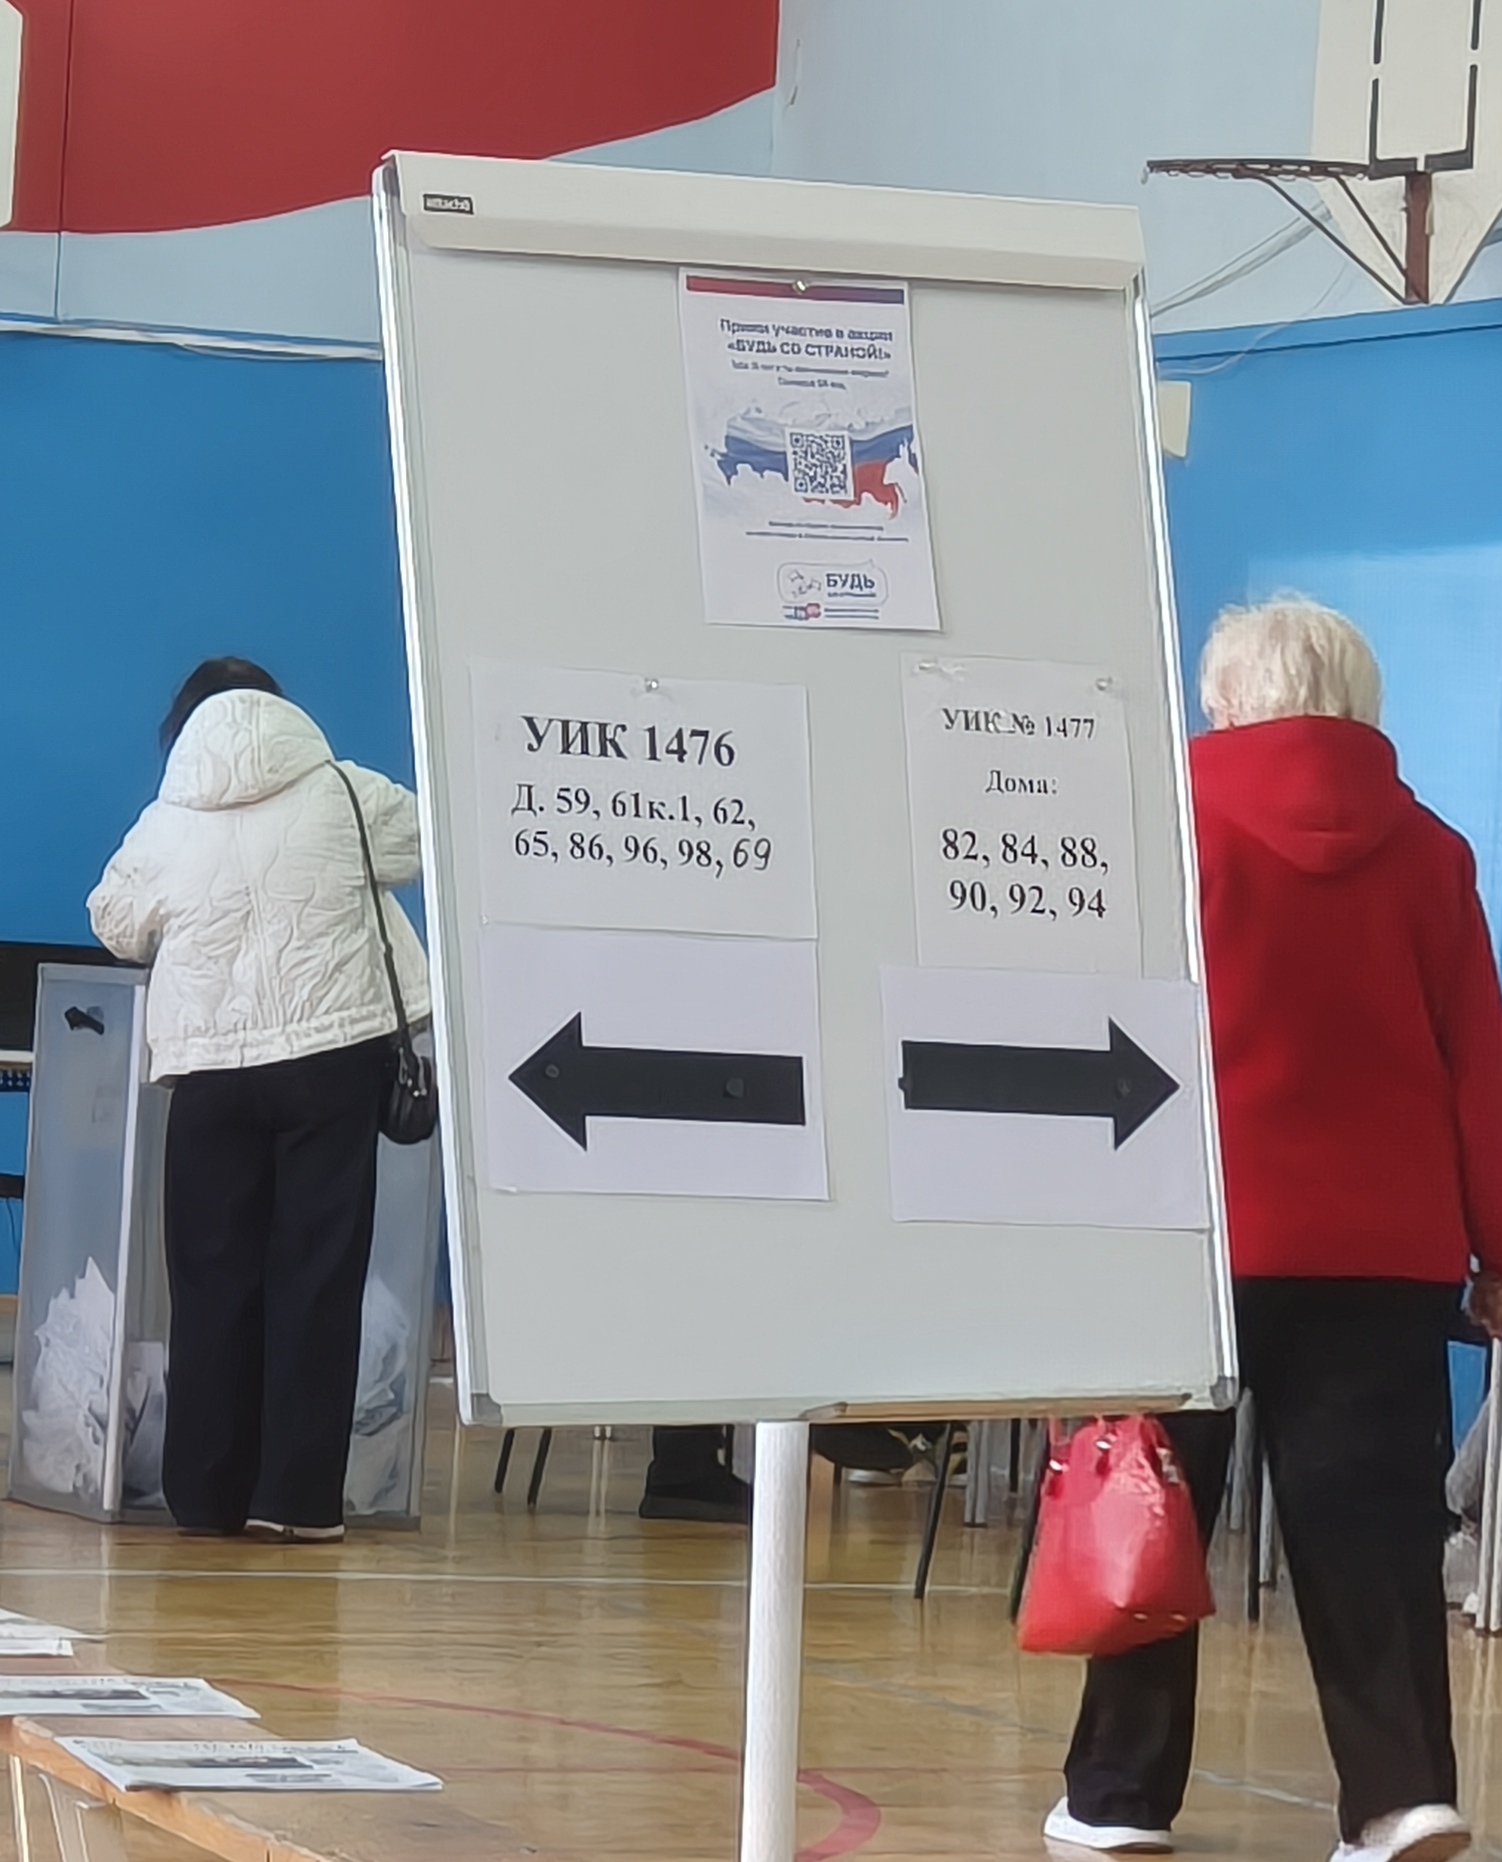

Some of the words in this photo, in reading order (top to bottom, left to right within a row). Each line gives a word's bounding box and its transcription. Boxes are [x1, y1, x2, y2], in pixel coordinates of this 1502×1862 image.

[728, 339, 777, 353] «БУДЬ
[780, 342, 802, 354] СО
[836, 329, 844, 339] в
[826, 573, 875, 591] БУДЬ
[942, 708, 1001, 733] УИК
[1046, 717, 1094, 738] 1477
[522, 716, 627, 759] УИК
[645, 726, 734, 766] 1476
[986, 770, 1056, 794] Дома:
[511, 784, 544, 816] Д.
[557, 788, 600, 820] 59,
[612, 791, 702, 827] 61к.1,
[714, 798, 755, 831] 62,
[516, 829, 558, 862] 65,
[570, 833, 613, 866] 86,
[625, 836, 667, 869] 96,
[679, 839, 723, 878] 98,
[734, 838, 771, 870] 69
[943, 829, 989, 867] 82,
[1002, 834, 1048, 868] 84,
[1061, 837, 1108, 874] 88,
[950, 880, 997, 918] 90,
[1009, 884, 1056, 920] 92,
[1069, 887, 1106, 918] 94
